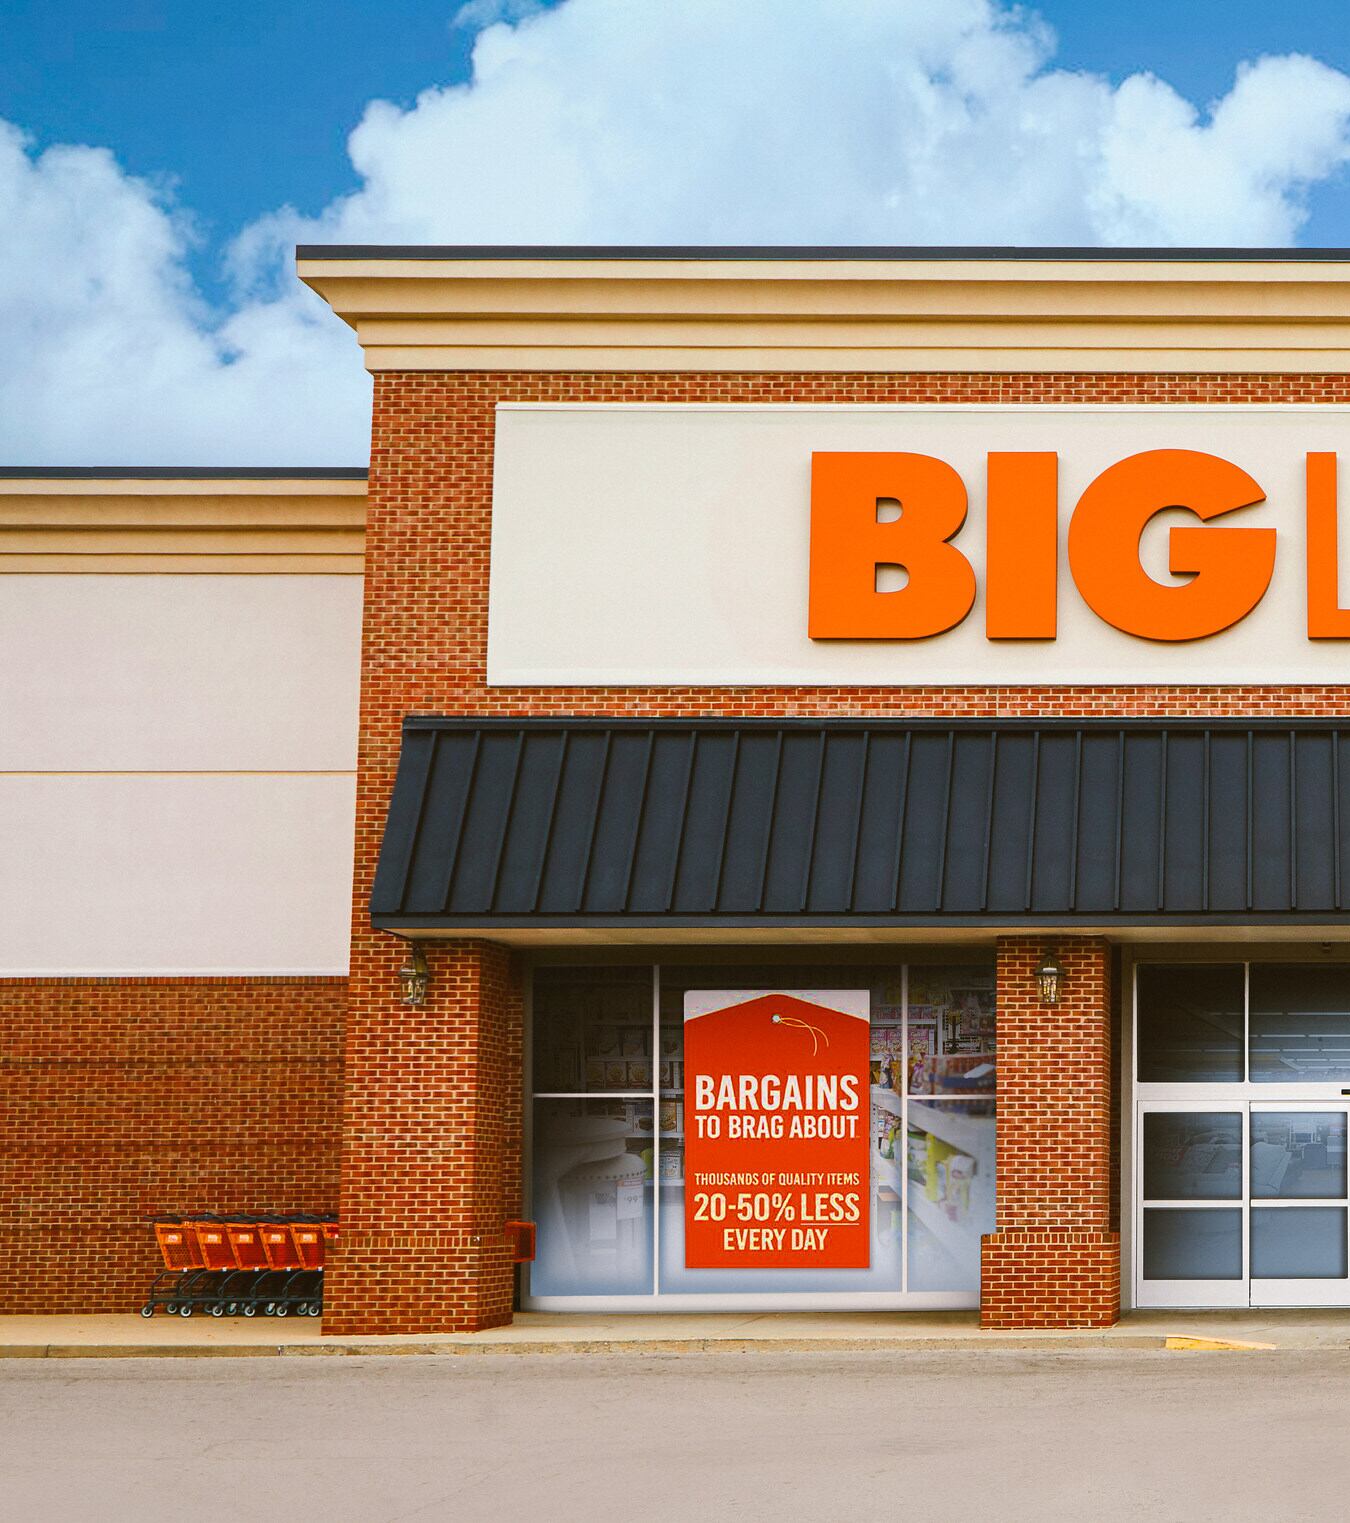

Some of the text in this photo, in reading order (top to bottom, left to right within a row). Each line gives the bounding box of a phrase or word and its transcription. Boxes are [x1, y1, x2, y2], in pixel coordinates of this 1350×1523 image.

[806, 447, 1277, 646] BIG
[695, 1074, 859, 1111] BARGAINS
[695, 1115, 859, 1139] TO BRAG ABOUT
[694, 1172, 860, 1187] THOUSANDS OF QUALITY ITEMS
[693, 1192, 860, 1222] 20-50% LESS
[723, 1228, 829, 1251] EVERY DAY
